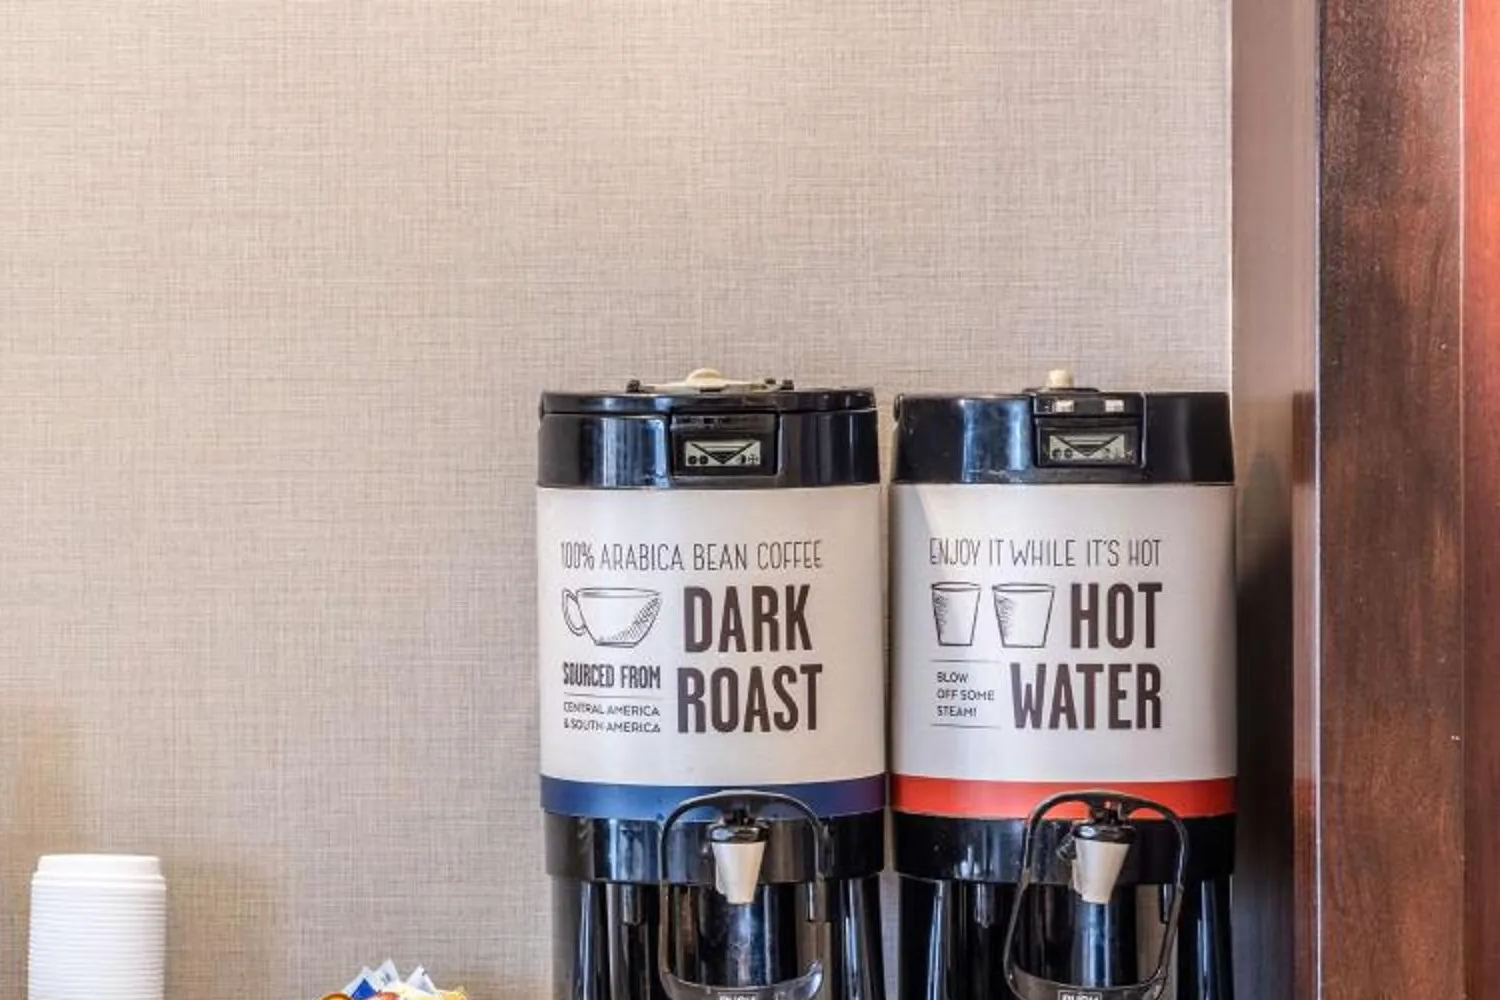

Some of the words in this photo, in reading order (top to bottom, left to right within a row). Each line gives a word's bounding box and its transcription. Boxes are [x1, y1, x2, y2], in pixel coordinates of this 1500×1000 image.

[560, 540, 595, 570] 100%
[599, 543, 685, 571] ARABICA
[693, 543, 748, 571] BEAN
[756, 540, 823, 570] COFFEE
[929, 537, 981, 566] ENJOY
[988, 538, 1004, 566] IT
[1009, 539, 1076, 567] WHILE
[1086, 539, 1120, 567] IT'S
[1128, 539, 1163, 567] HOT
[683, 584, 813, 653] DARK
[1070, 582, 1163, 649] HOT
[562, 661, 615, 688] SOURCED
[620, 664, 661, 690] FROM
[937, 671, 970, 683] BLOW
[676, 663, 823, 734] ROAST
[936, 687, 958, 701] OFF
[960, 689, 995, 701] SOME
[1009, 661, 1163, 730] WATER
[563, 701, 605, 715] CENTRAL
[606, 703, 661, 717] AMERICA
[936, 705, 978, 718] STEAM!
[570, 718, 605, 731] SOUTH
[606, 720, 661, 733] AMERICA
